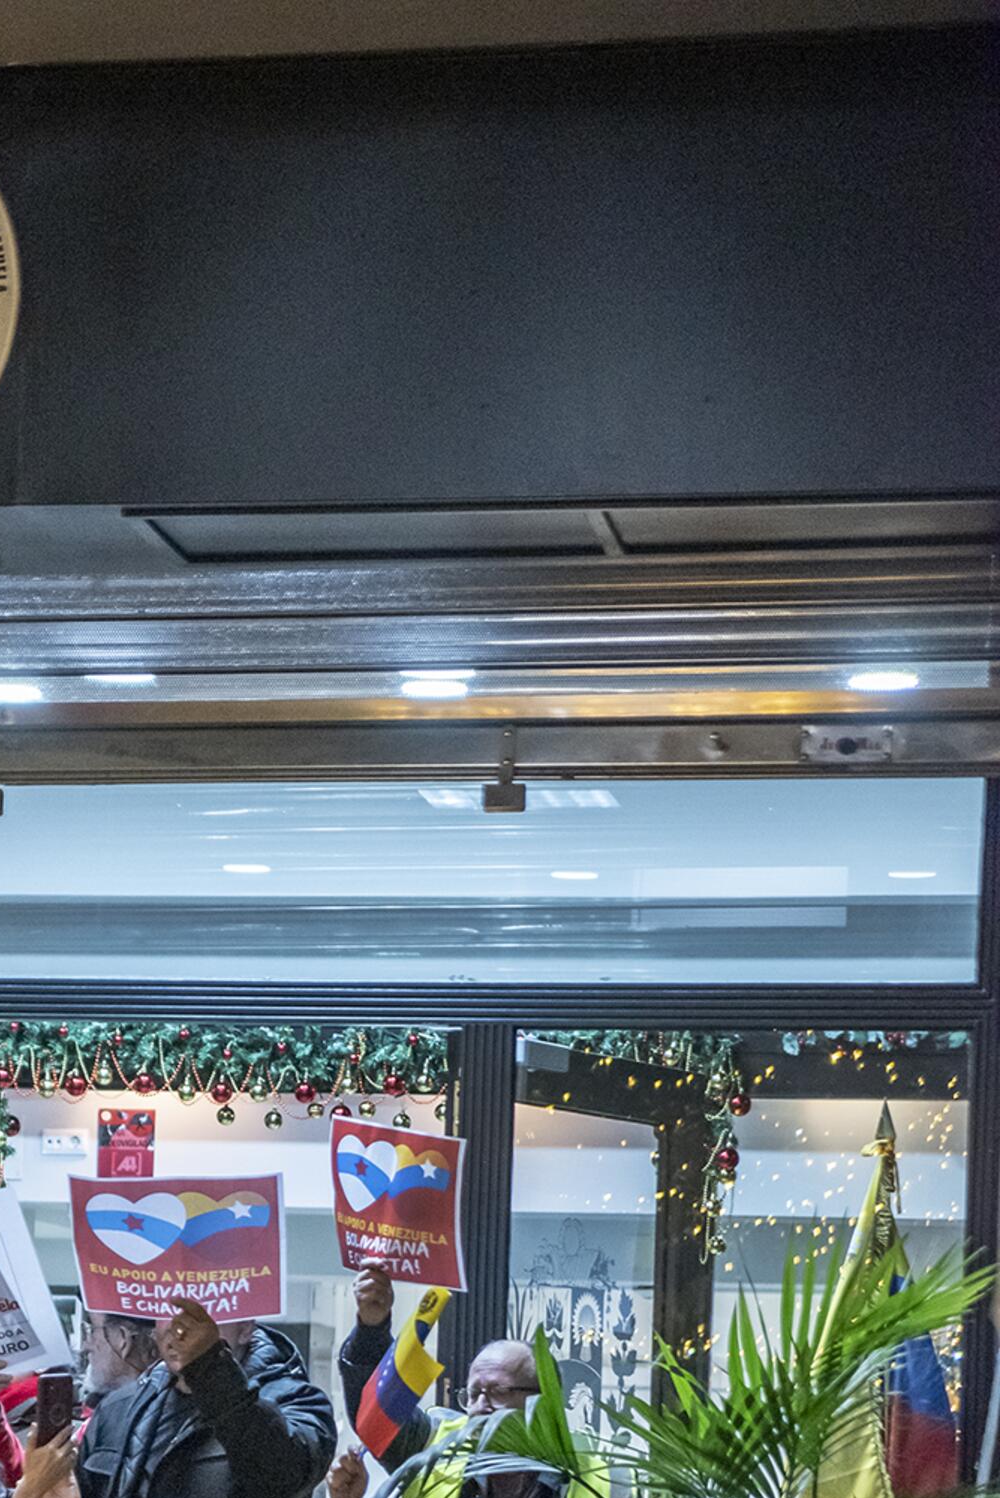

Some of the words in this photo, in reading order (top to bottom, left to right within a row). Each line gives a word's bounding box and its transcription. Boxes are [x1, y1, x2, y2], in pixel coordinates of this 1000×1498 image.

[345, 1230, 430, 1259] BOLIVARIANA
[377, 1223, 449, 1246] VENEZUELA
[88, 1263, 108, 1276] EU
[111, 1267, 157, 1282] APOIO
[160, 1271, 172, 1282] A
[175, 1265, 272, 1283] VENEZUELA
[354, 1251, 421, 1276] CSTA!
[116, 1277, 250, 1300] BOLIVARIANA
[121, 1298, 132, 1309] E
[136, 1295, 238, 1316] CHAVTA!
